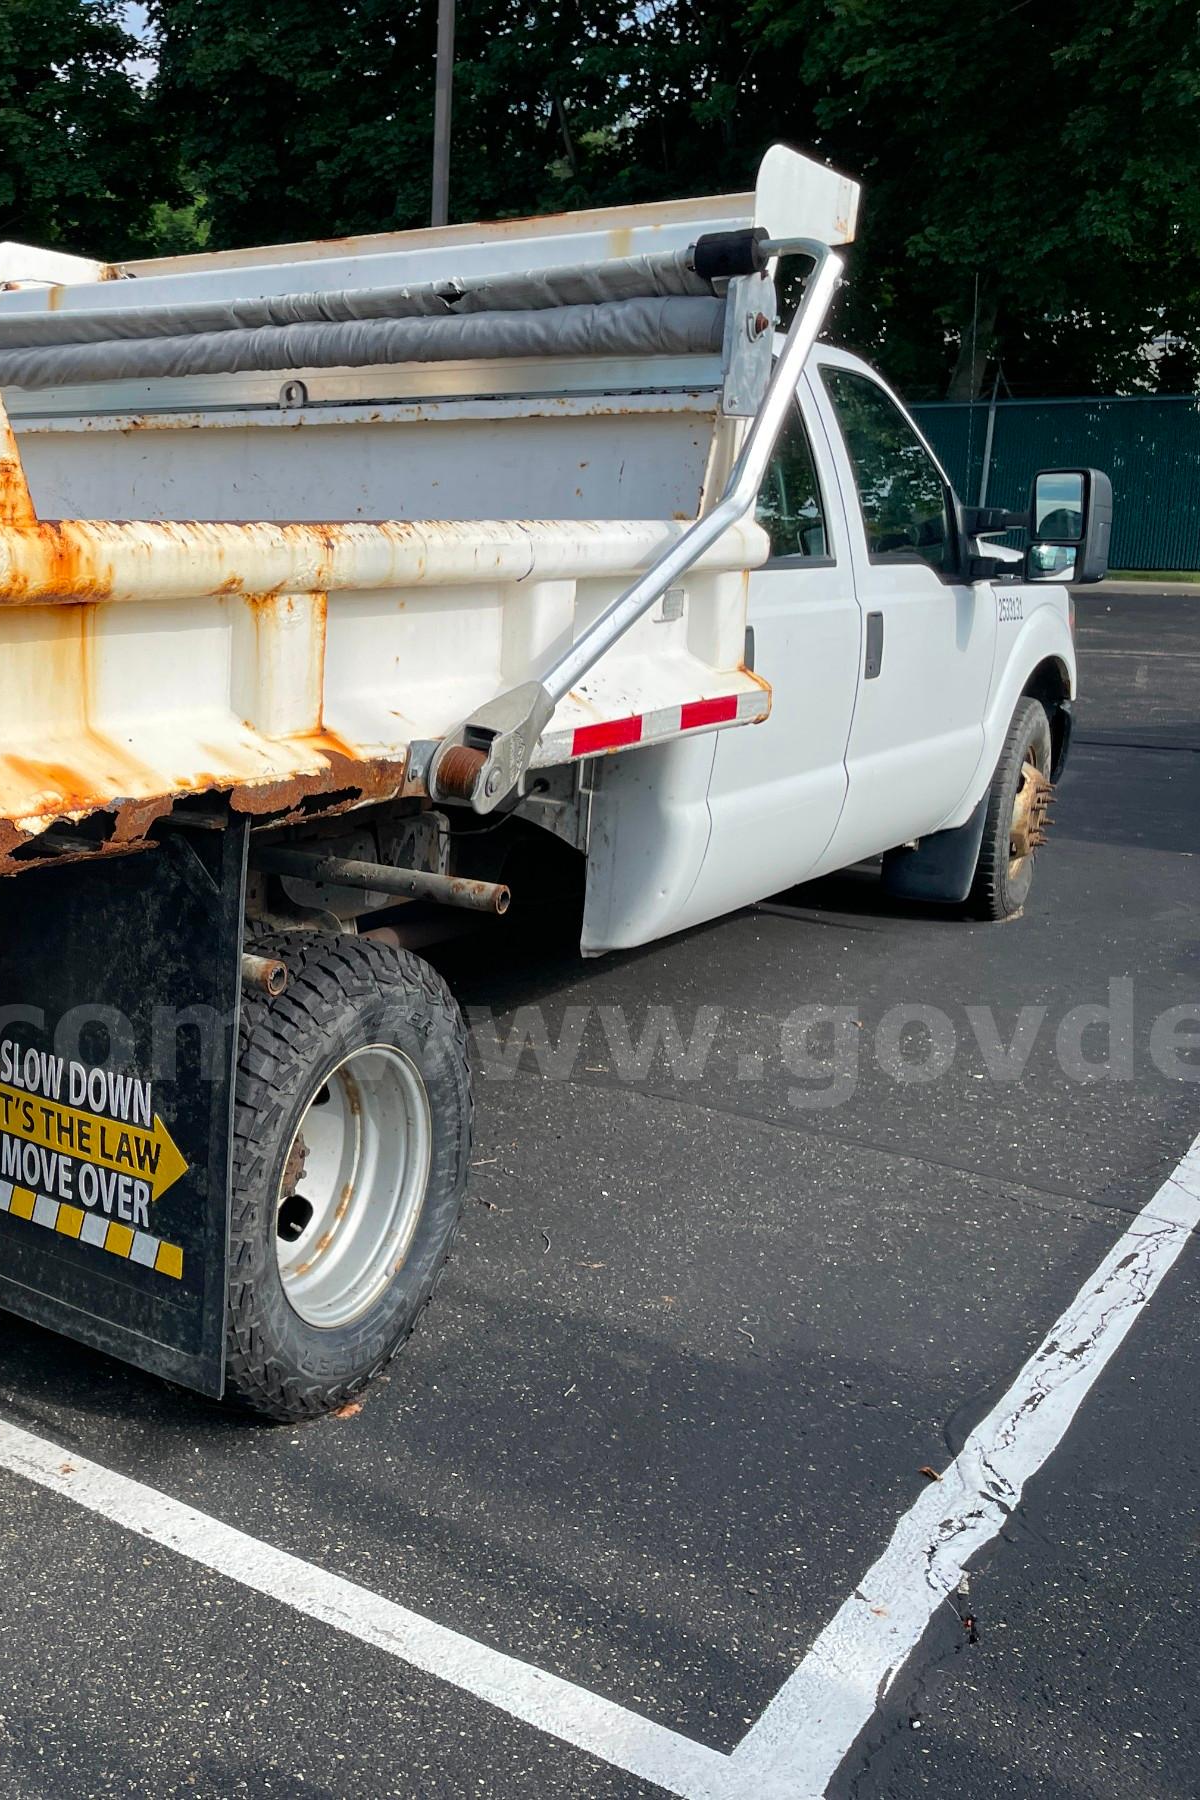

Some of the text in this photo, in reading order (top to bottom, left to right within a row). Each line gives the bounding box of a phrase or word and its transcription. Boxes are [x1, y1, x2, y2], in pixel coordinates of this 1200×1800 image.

[0, 1039, 151, 1126] SLOW DOWN
[1, 1133, 149, 1228] MOVE OVER
[40, 1107, 91, 1154] THE
[99, 1126, 160, 1175] LAW
